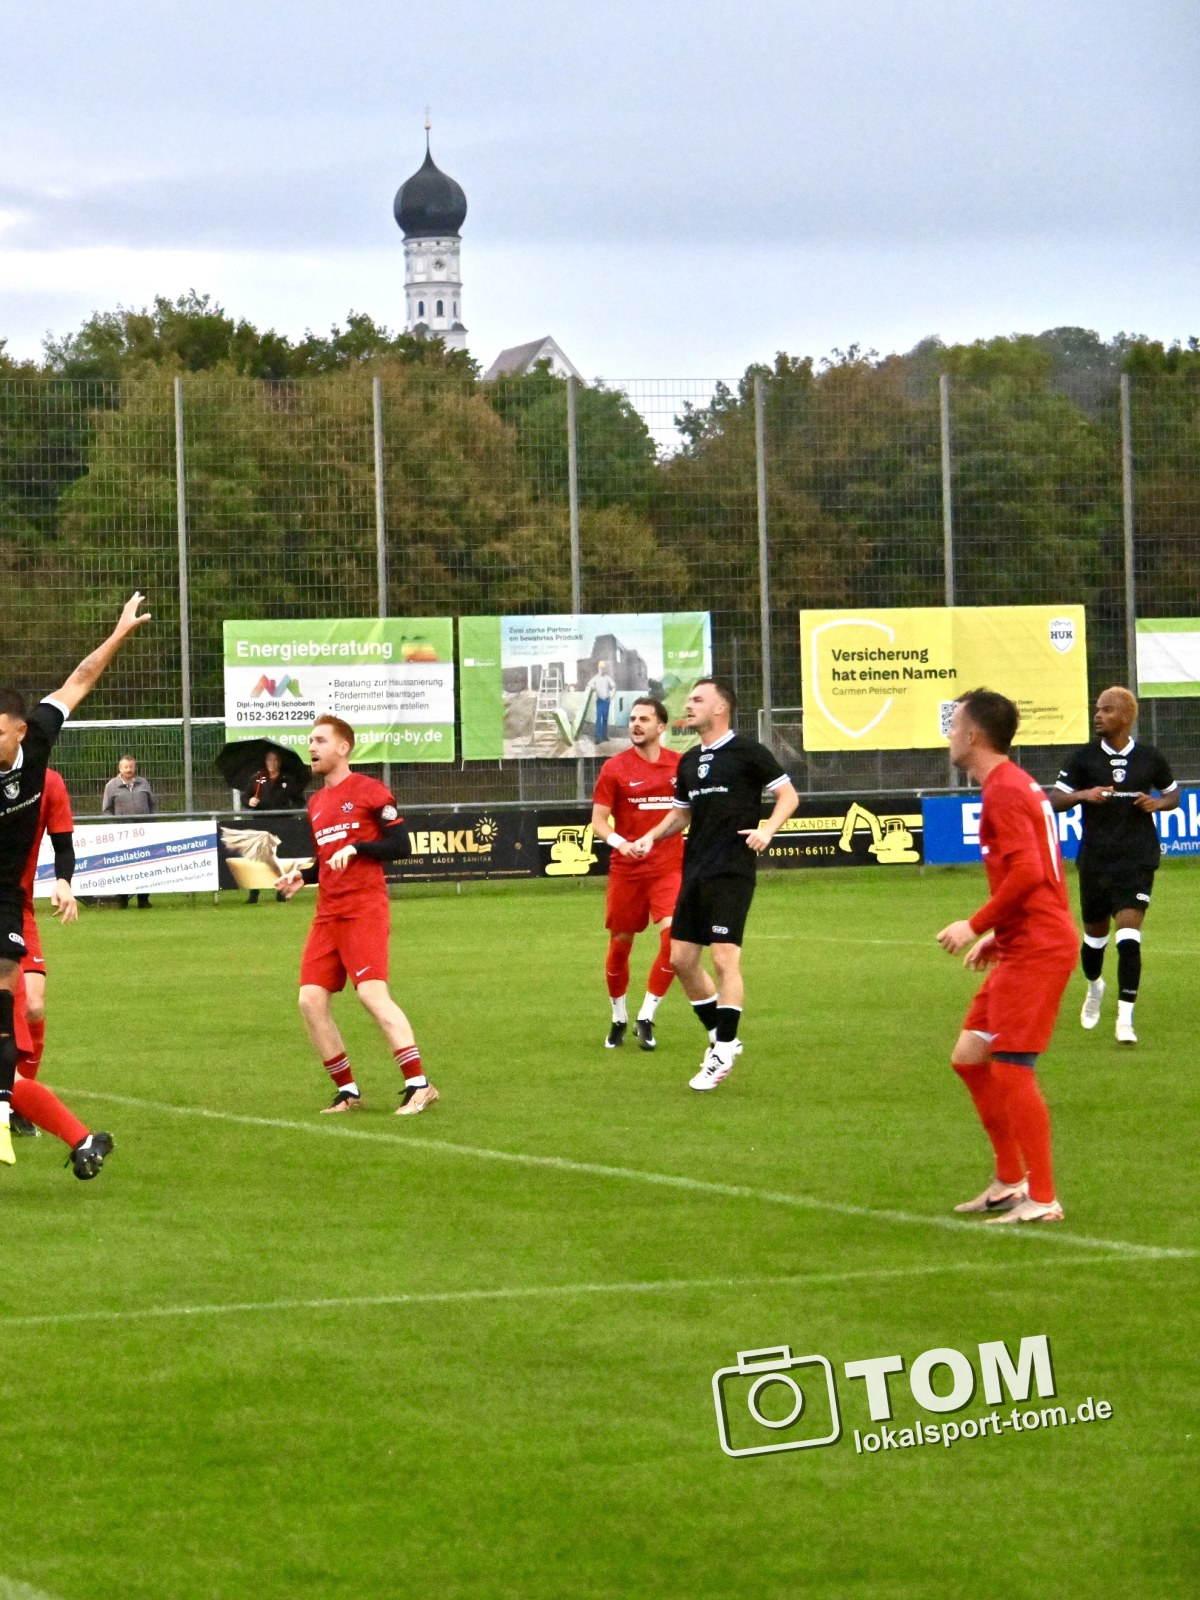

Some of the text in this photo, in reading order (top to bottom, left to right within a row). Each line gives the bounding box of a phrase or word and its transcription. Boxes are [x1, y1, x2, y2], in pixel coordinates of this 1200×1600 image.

[1050, 631, 1073, 639] HUK
[236, 640, 393, 660] Energieberatung
[832, 648, 929, 663] Versicherung
[832, 667, 957, 681] hat einen Namen
[334, 680, 371, 688] Beratung
[832, 687, 867, 695] Carmen
[335, 703, 398, 712] Energieausweis
[237, 711, 315, 721] 0152-36212296
[95, 833, 115, 845] 888
[117, 830, 129, 841] 77
[132, 828, 145, 838] 80
[103, 850, 151, 865] Installation
[166, 839, 208, 854] Reparatur
[769, 846, 836, 857] 08191-66112
[80, 859, 212, 890] info@elektroteam-hurlach.de
